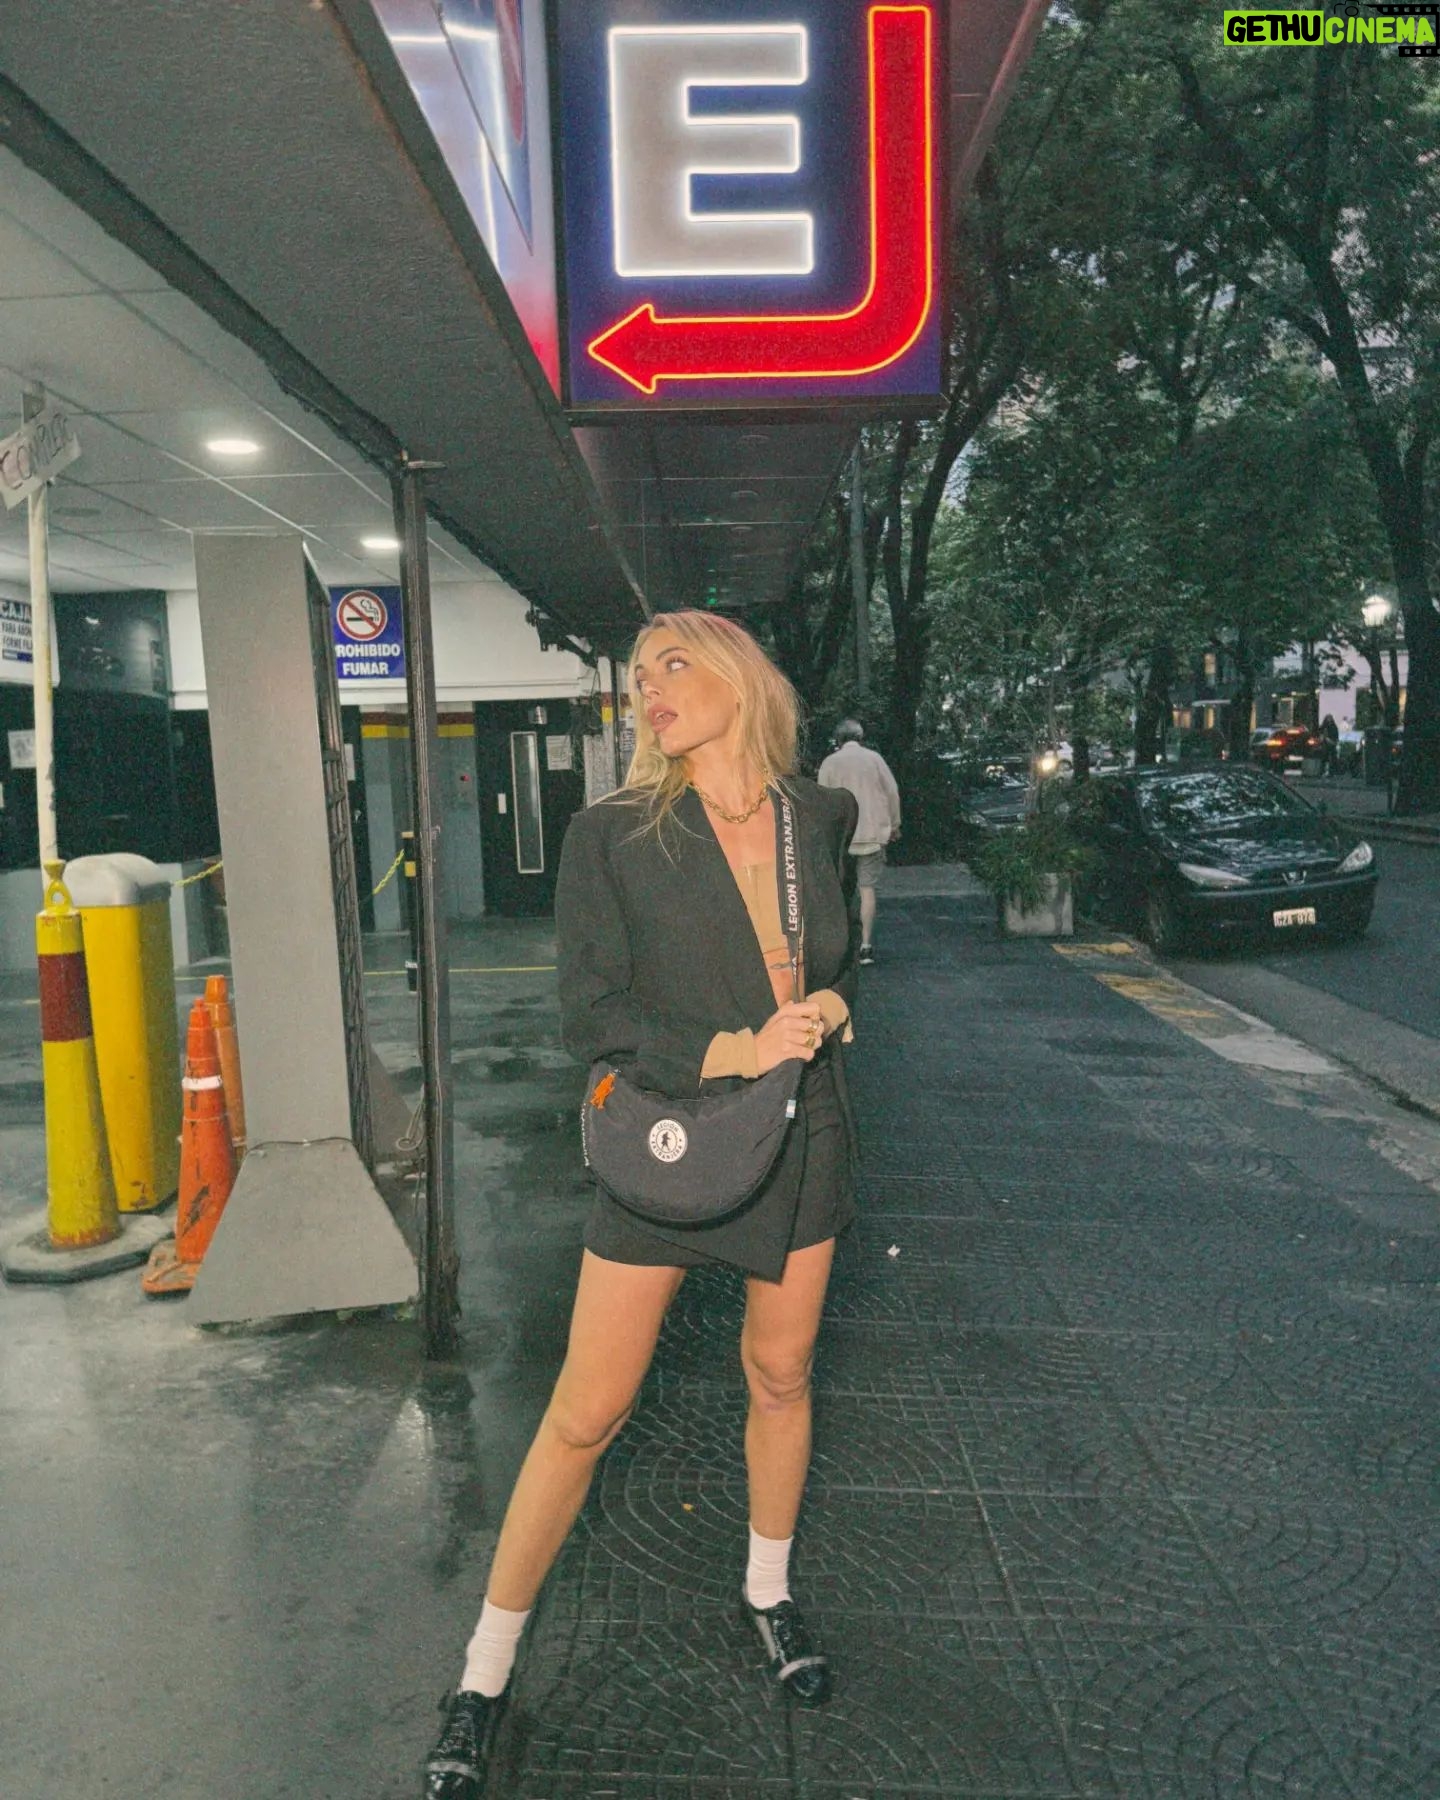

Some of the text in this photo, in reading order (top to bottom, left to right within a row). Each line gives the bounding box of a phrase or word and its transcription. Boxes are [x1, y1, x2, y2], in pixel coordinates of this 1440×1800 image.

[608, 24, 814, 277] E
[334, 643, 401, 657] ROHIBIDO
[342, 662, 389, 676] FUMAR
[786, 883, 798, 932] LEGION
